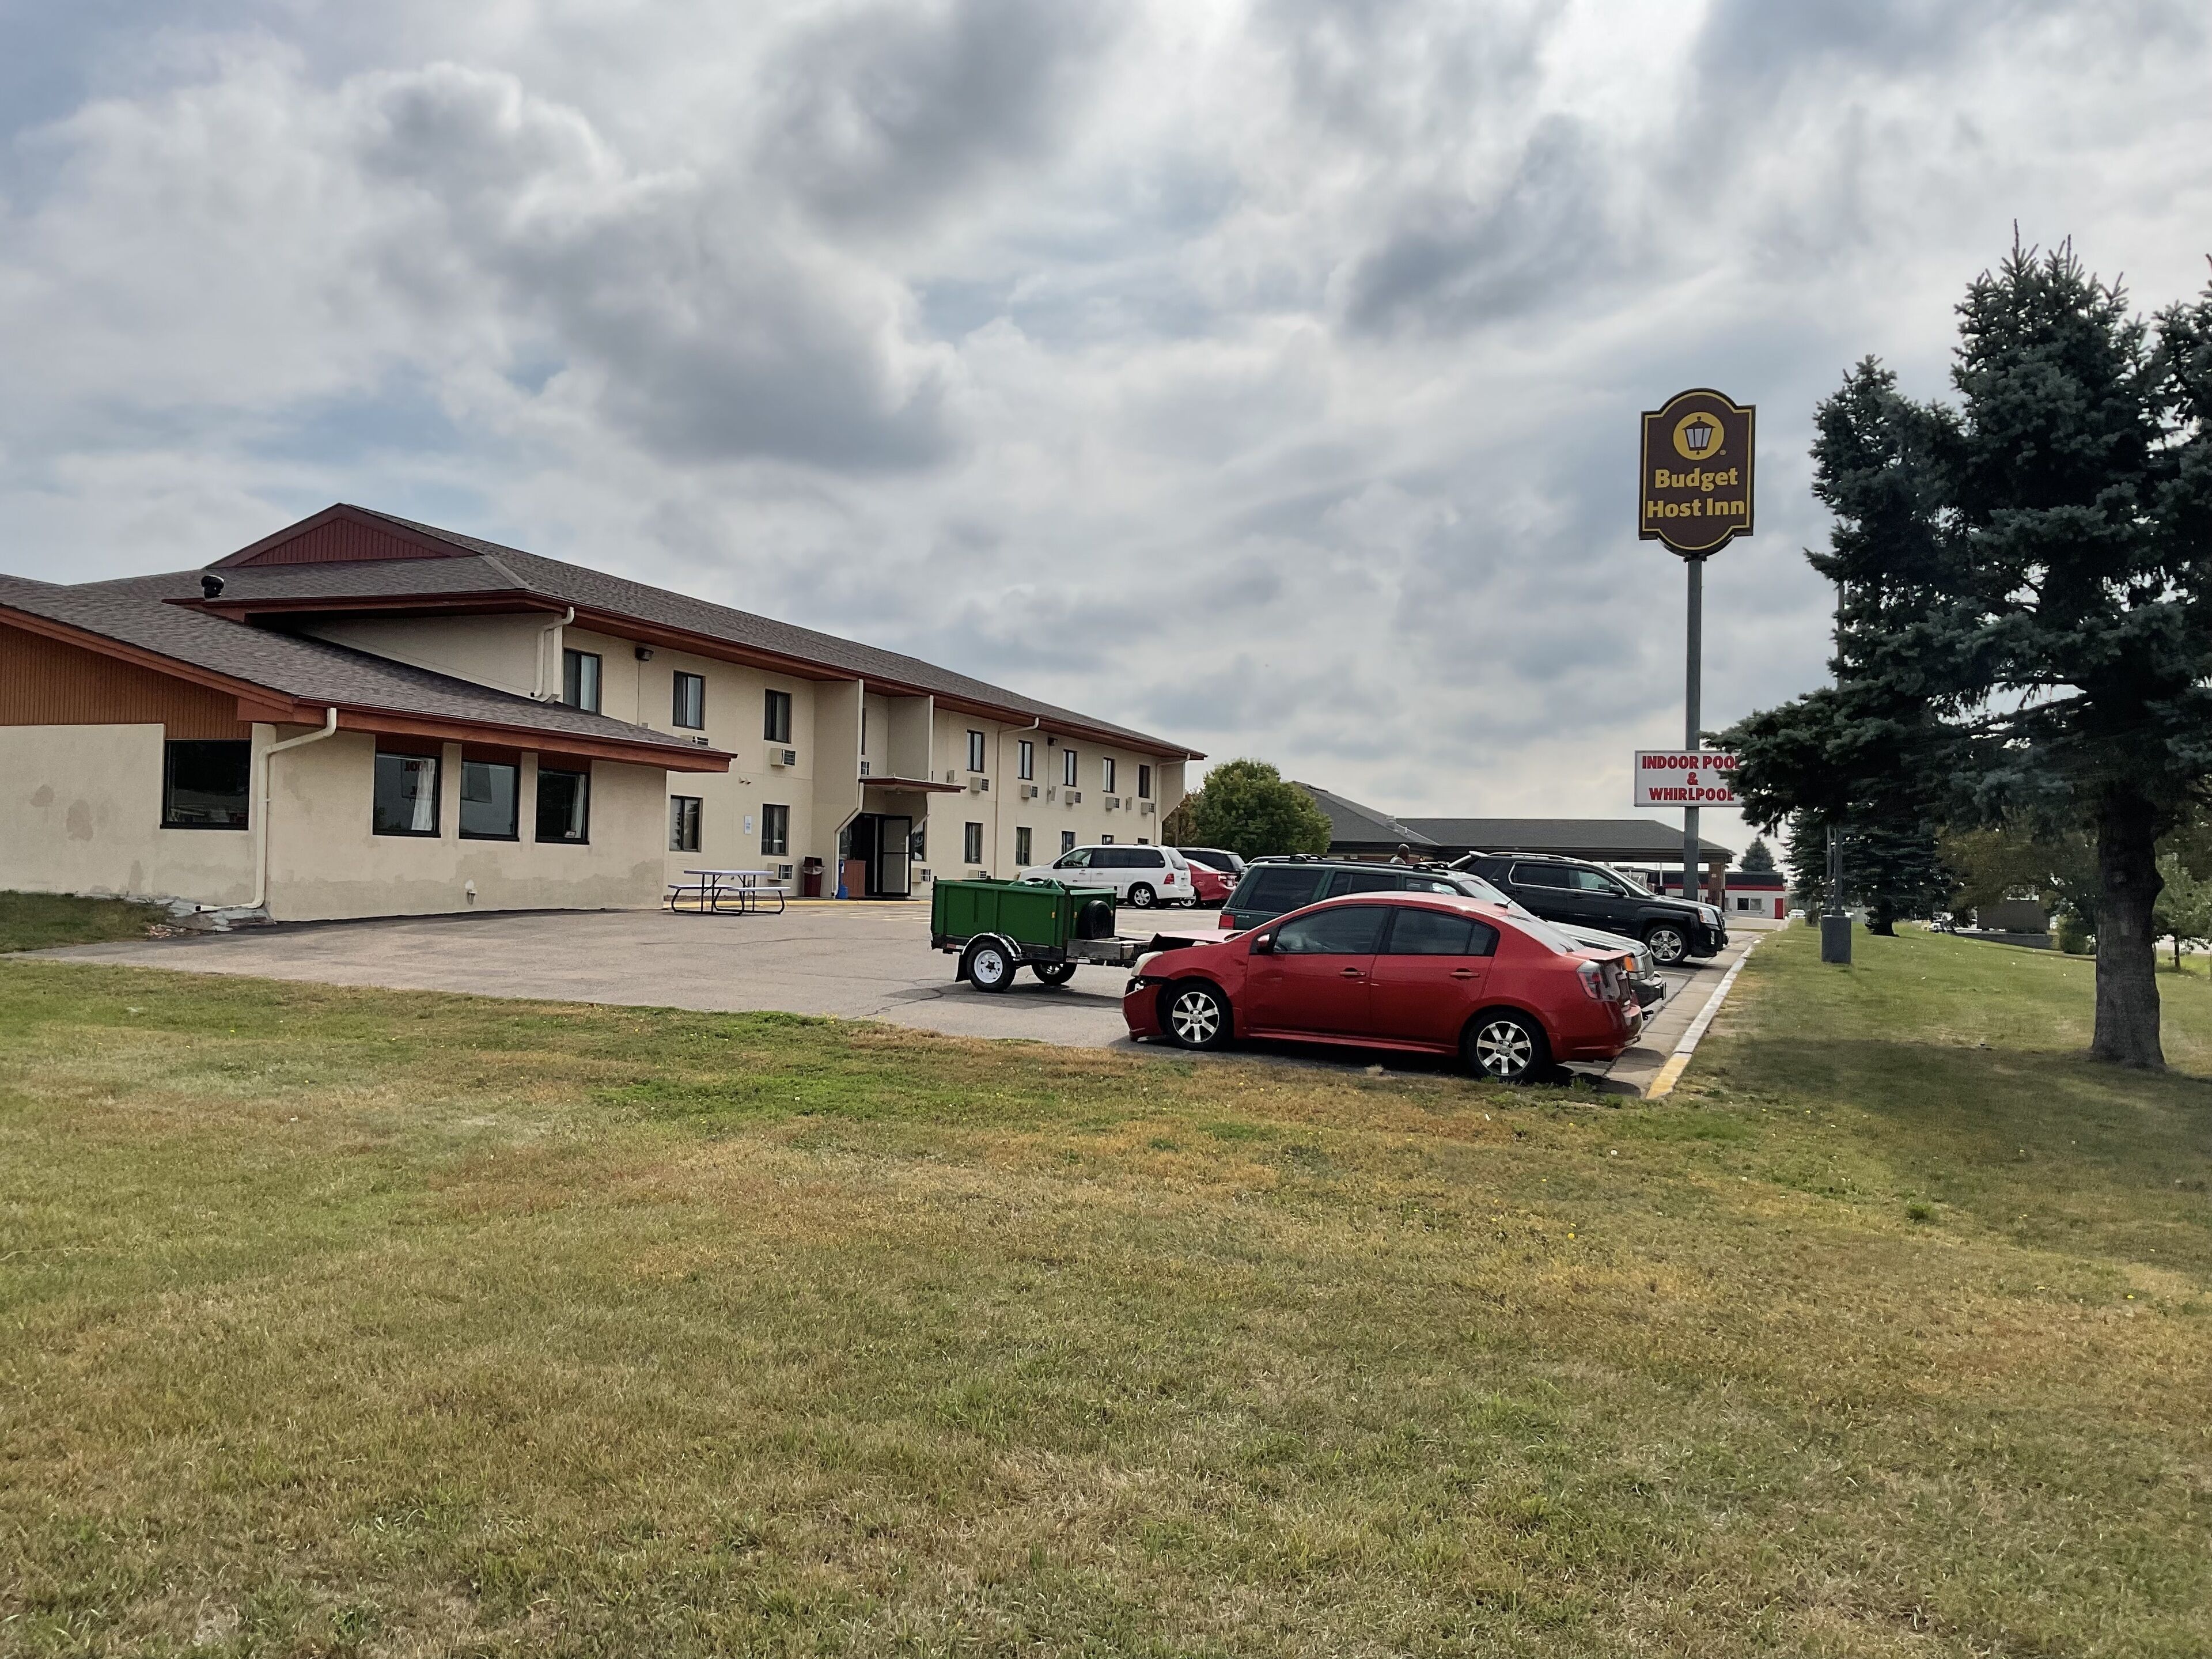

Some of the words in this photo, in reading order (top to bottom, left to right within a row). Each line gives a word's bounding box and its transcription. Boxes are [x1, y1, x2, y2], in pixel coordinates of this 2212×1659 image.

[1654, 467, 1738, 491] Budget
[1647, 498, 1701, 518] Host
[1706, 498, 1745, 516] Inn
[1642, 755, 1699, 769] INDOOR
[1687, 771, 1699, 786] &
[1649, 787, 1734, 801] WHIRLPOOL
